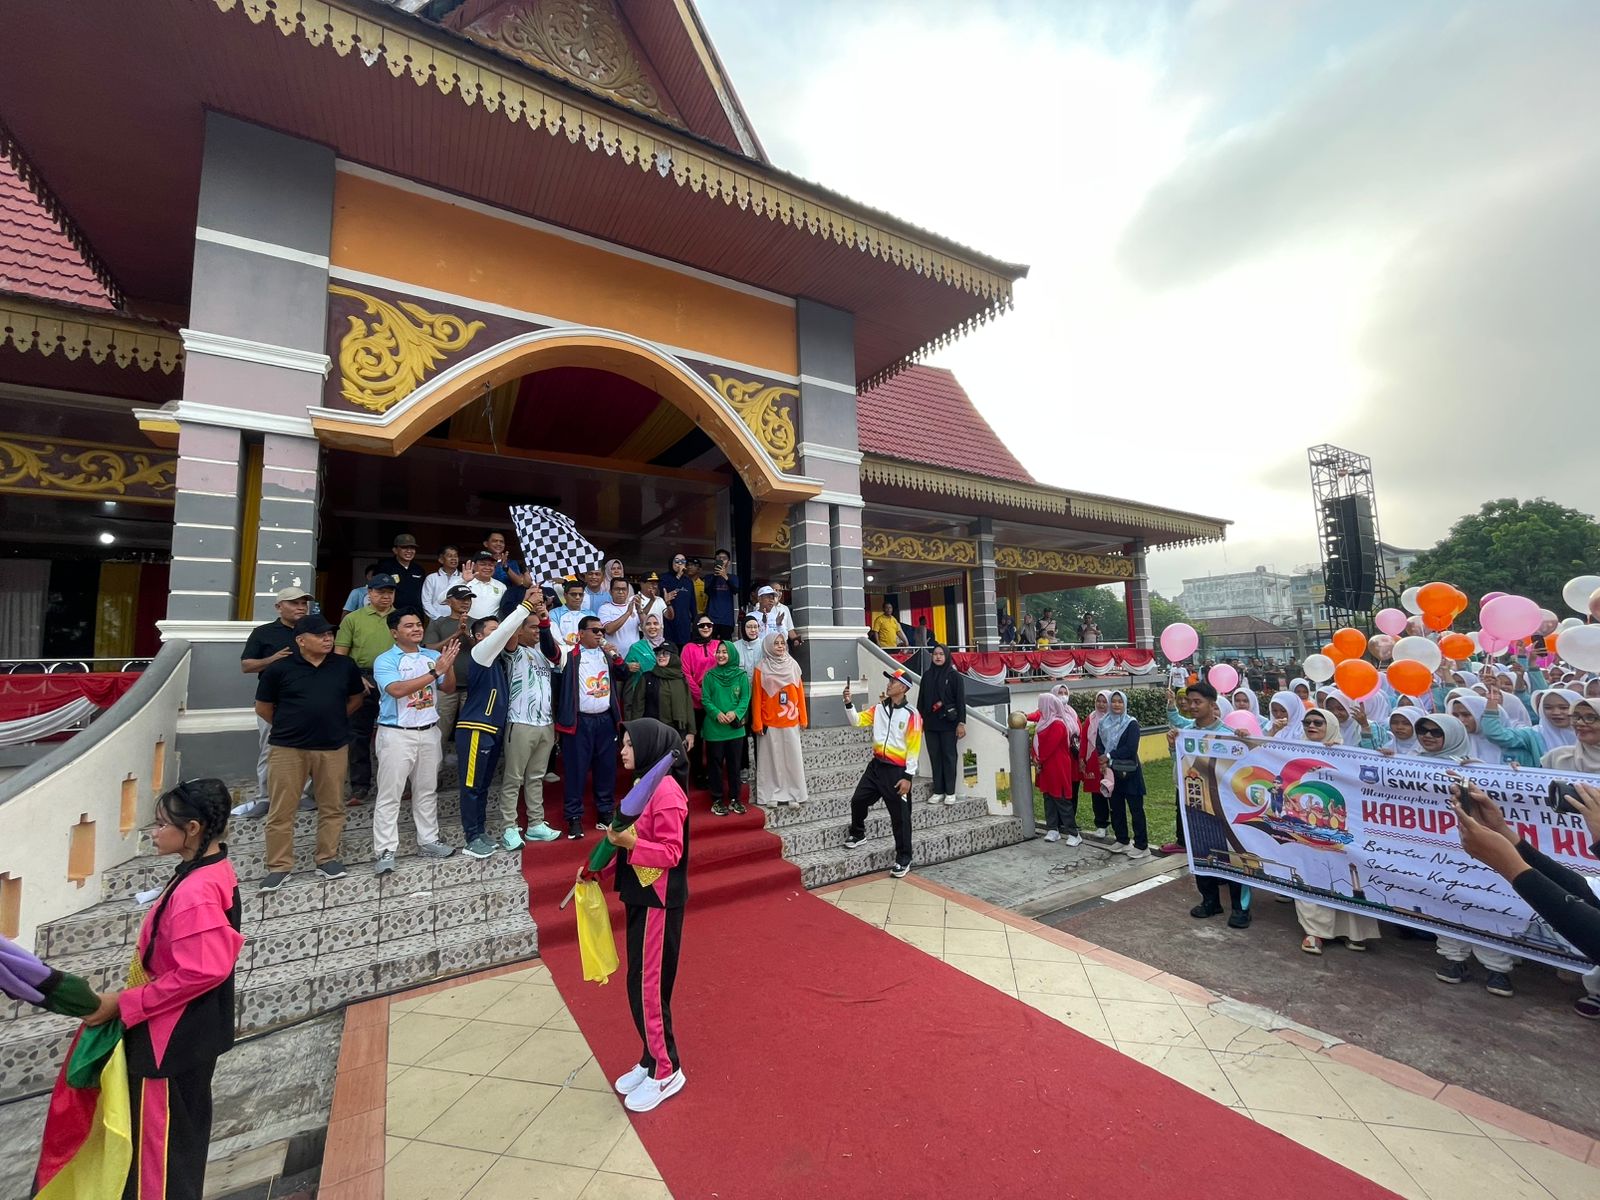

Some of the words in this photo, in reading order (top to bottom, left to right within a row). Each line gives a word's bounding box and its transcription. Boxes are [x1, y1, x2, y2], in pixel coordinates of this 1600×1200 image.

[1387, 767, 1420, 779] KAMI
[1424, 772, 1500, 789] KELURGA
[1505, 780, 1546, 793] BESA
[1387, 778, 1429, 793] SMK
[1511, 792, 1526, 804] 2
[1360, 787, 1440, 807] Mengucapkan
[1363, 858, 1424, 878] Salam
